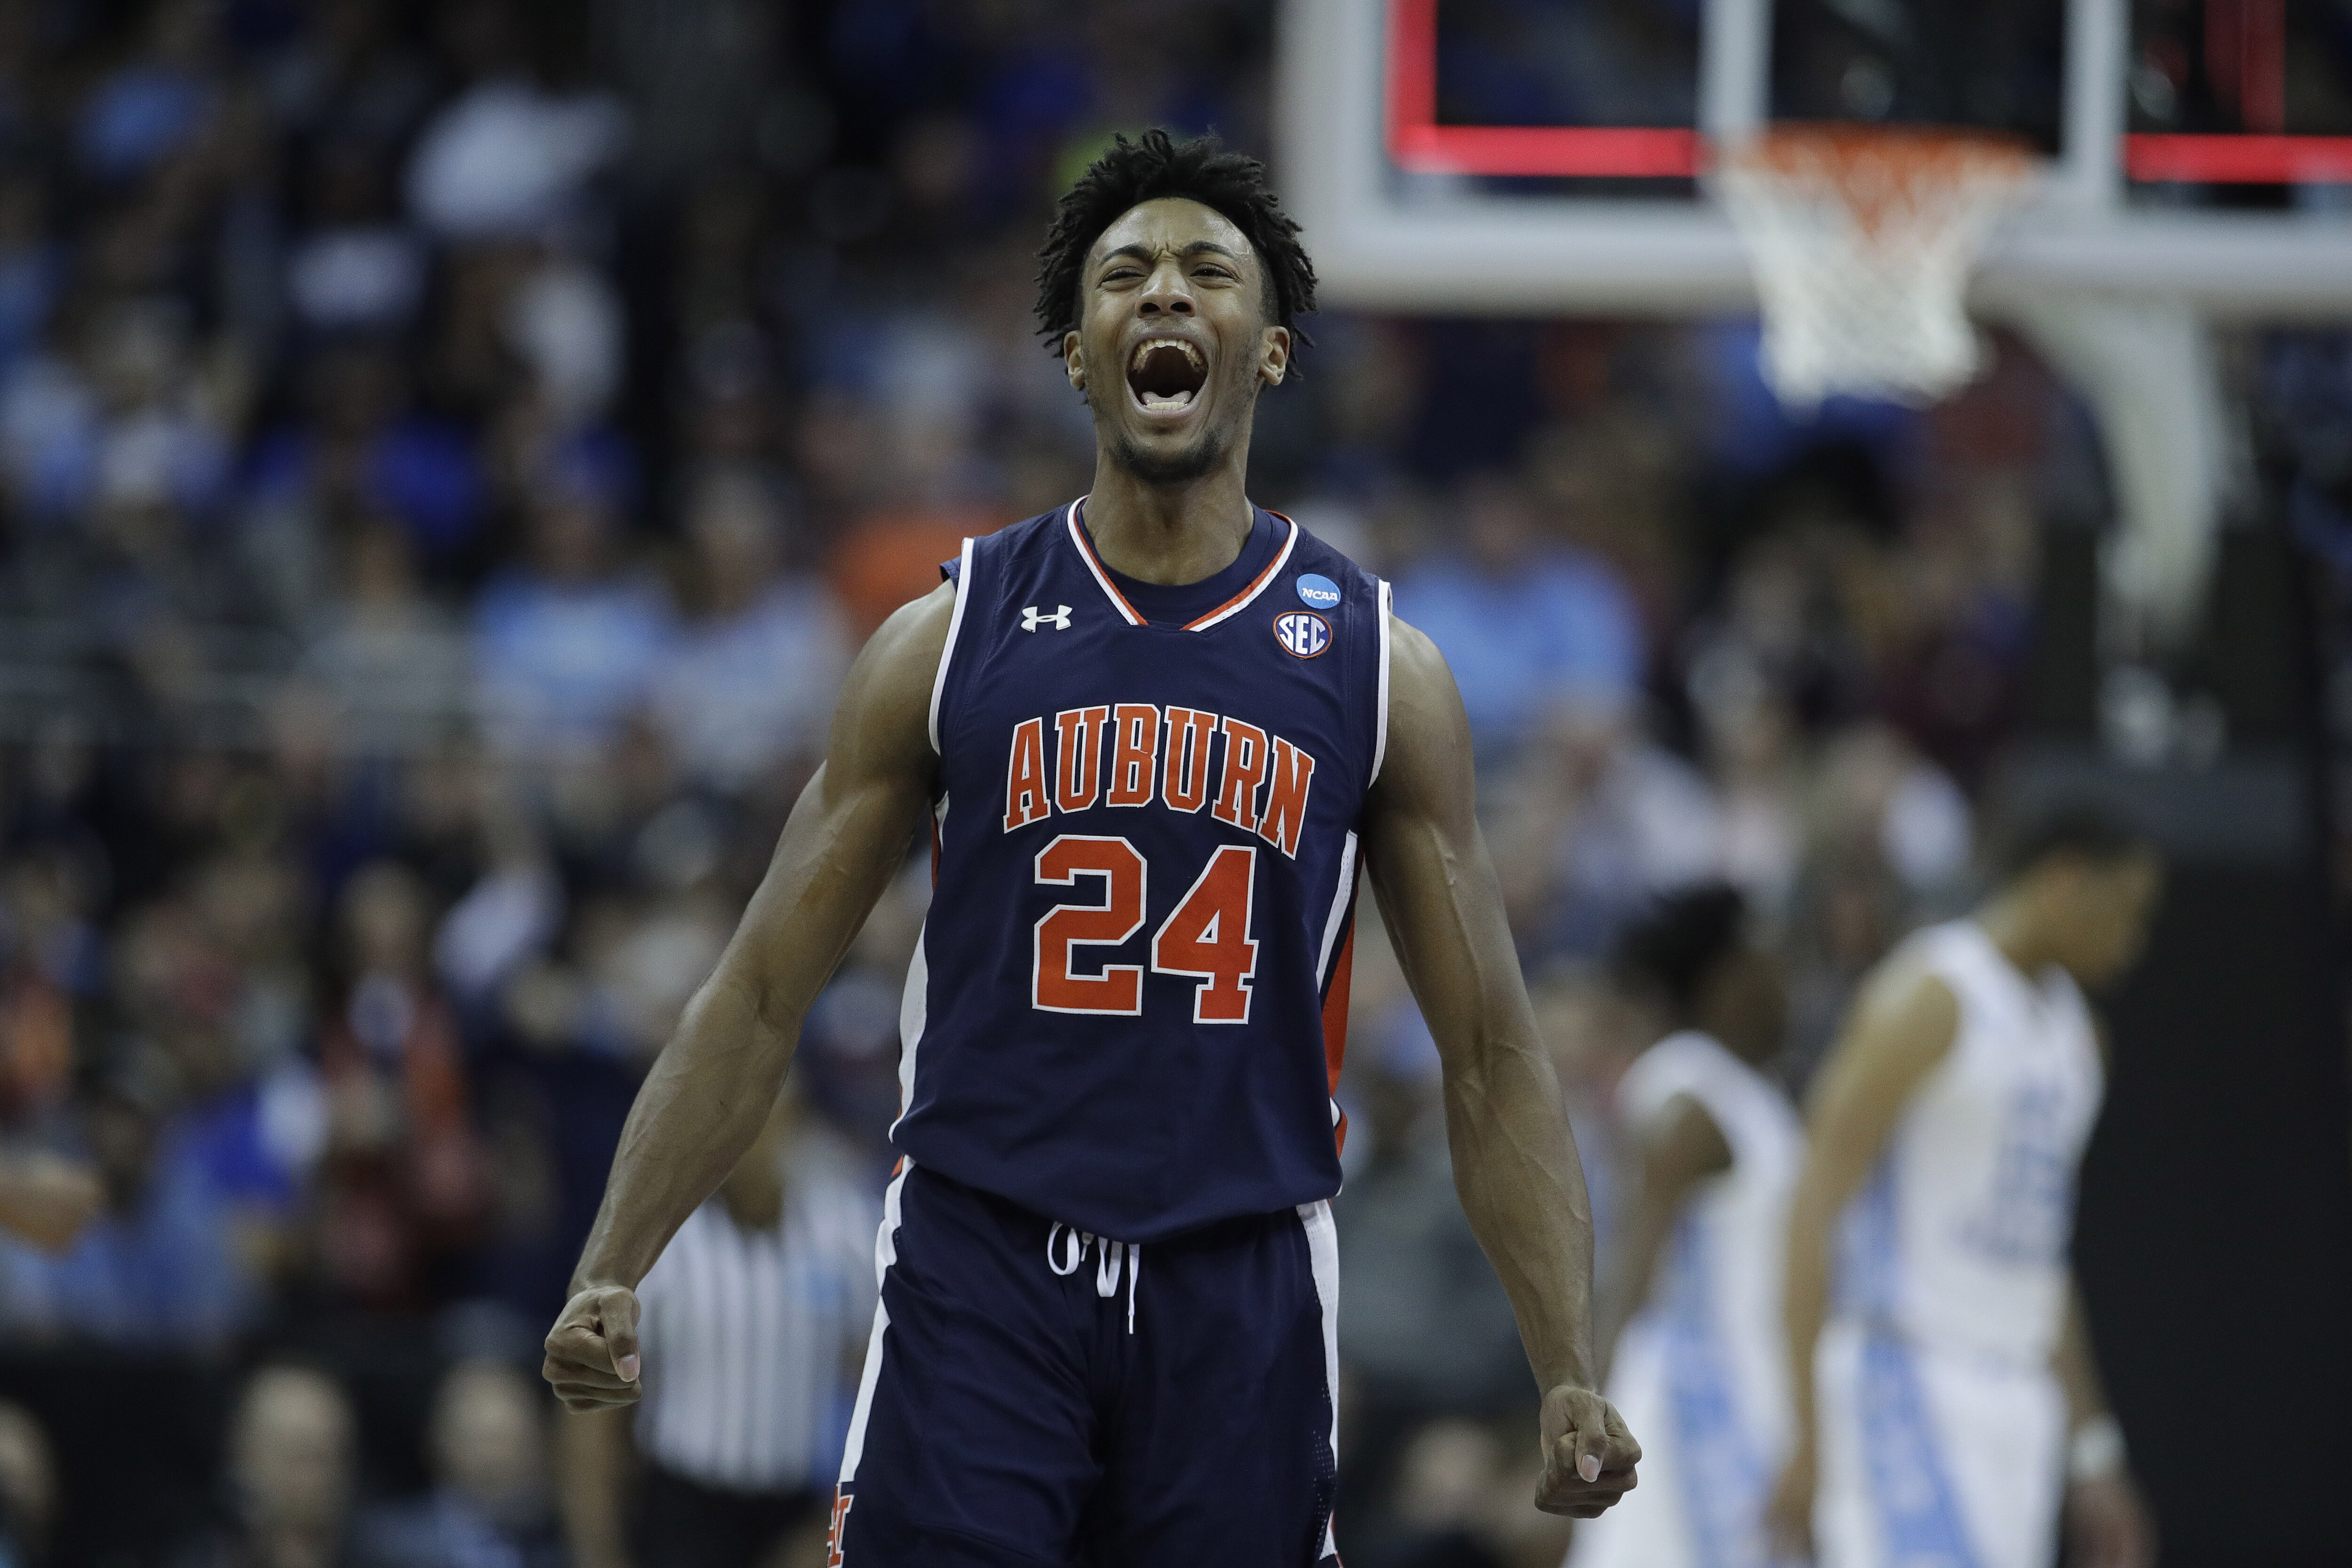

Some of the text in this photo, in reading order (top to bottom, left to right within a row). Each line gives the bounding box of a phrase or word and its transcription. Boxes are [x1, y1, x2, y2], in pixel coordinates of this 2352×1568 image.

[1279, 614, 1326, 654] SEC
[1302, 588, 1338, 601] NCAA
[1003, 703, 1315, 860] AUBURN
[1032, 834, 1259, 1025] 24
